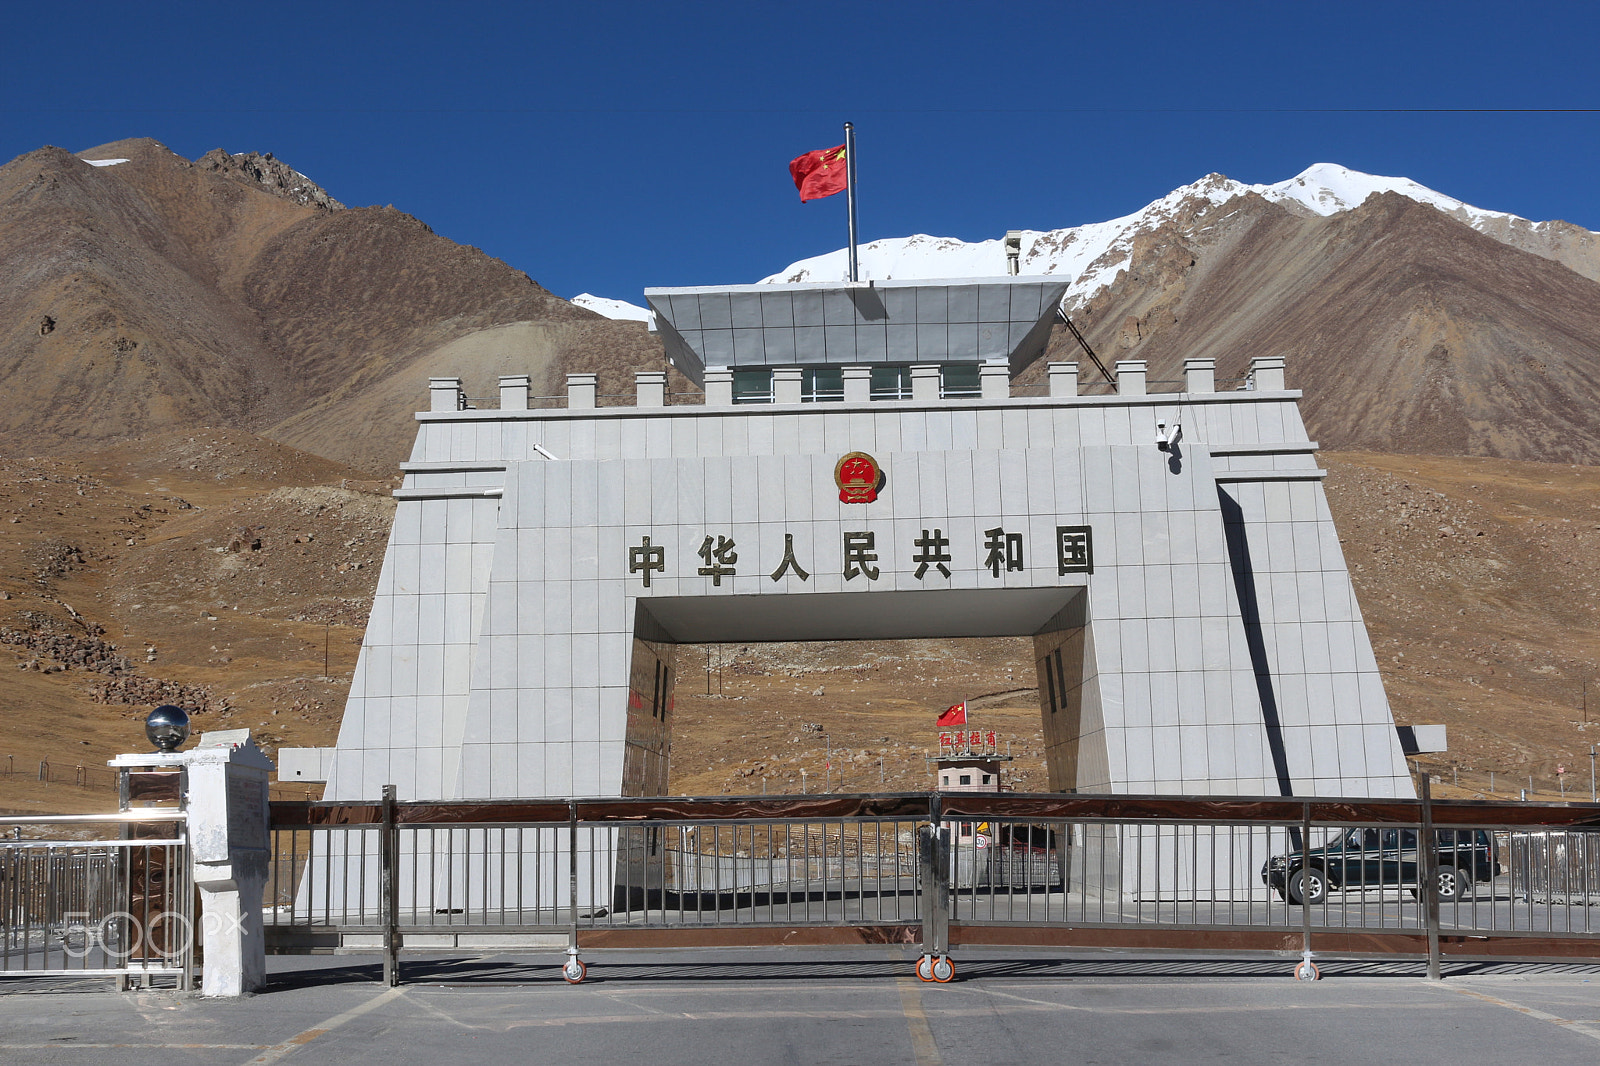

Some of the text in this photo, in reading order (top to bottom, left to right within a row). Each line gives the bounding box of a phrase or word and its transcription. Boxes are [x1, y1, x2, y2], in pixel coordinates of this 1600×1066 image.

[629, 525, 1094, 587] 中华人民共和国
[939, 731, 996, 748] 红其拉甫
